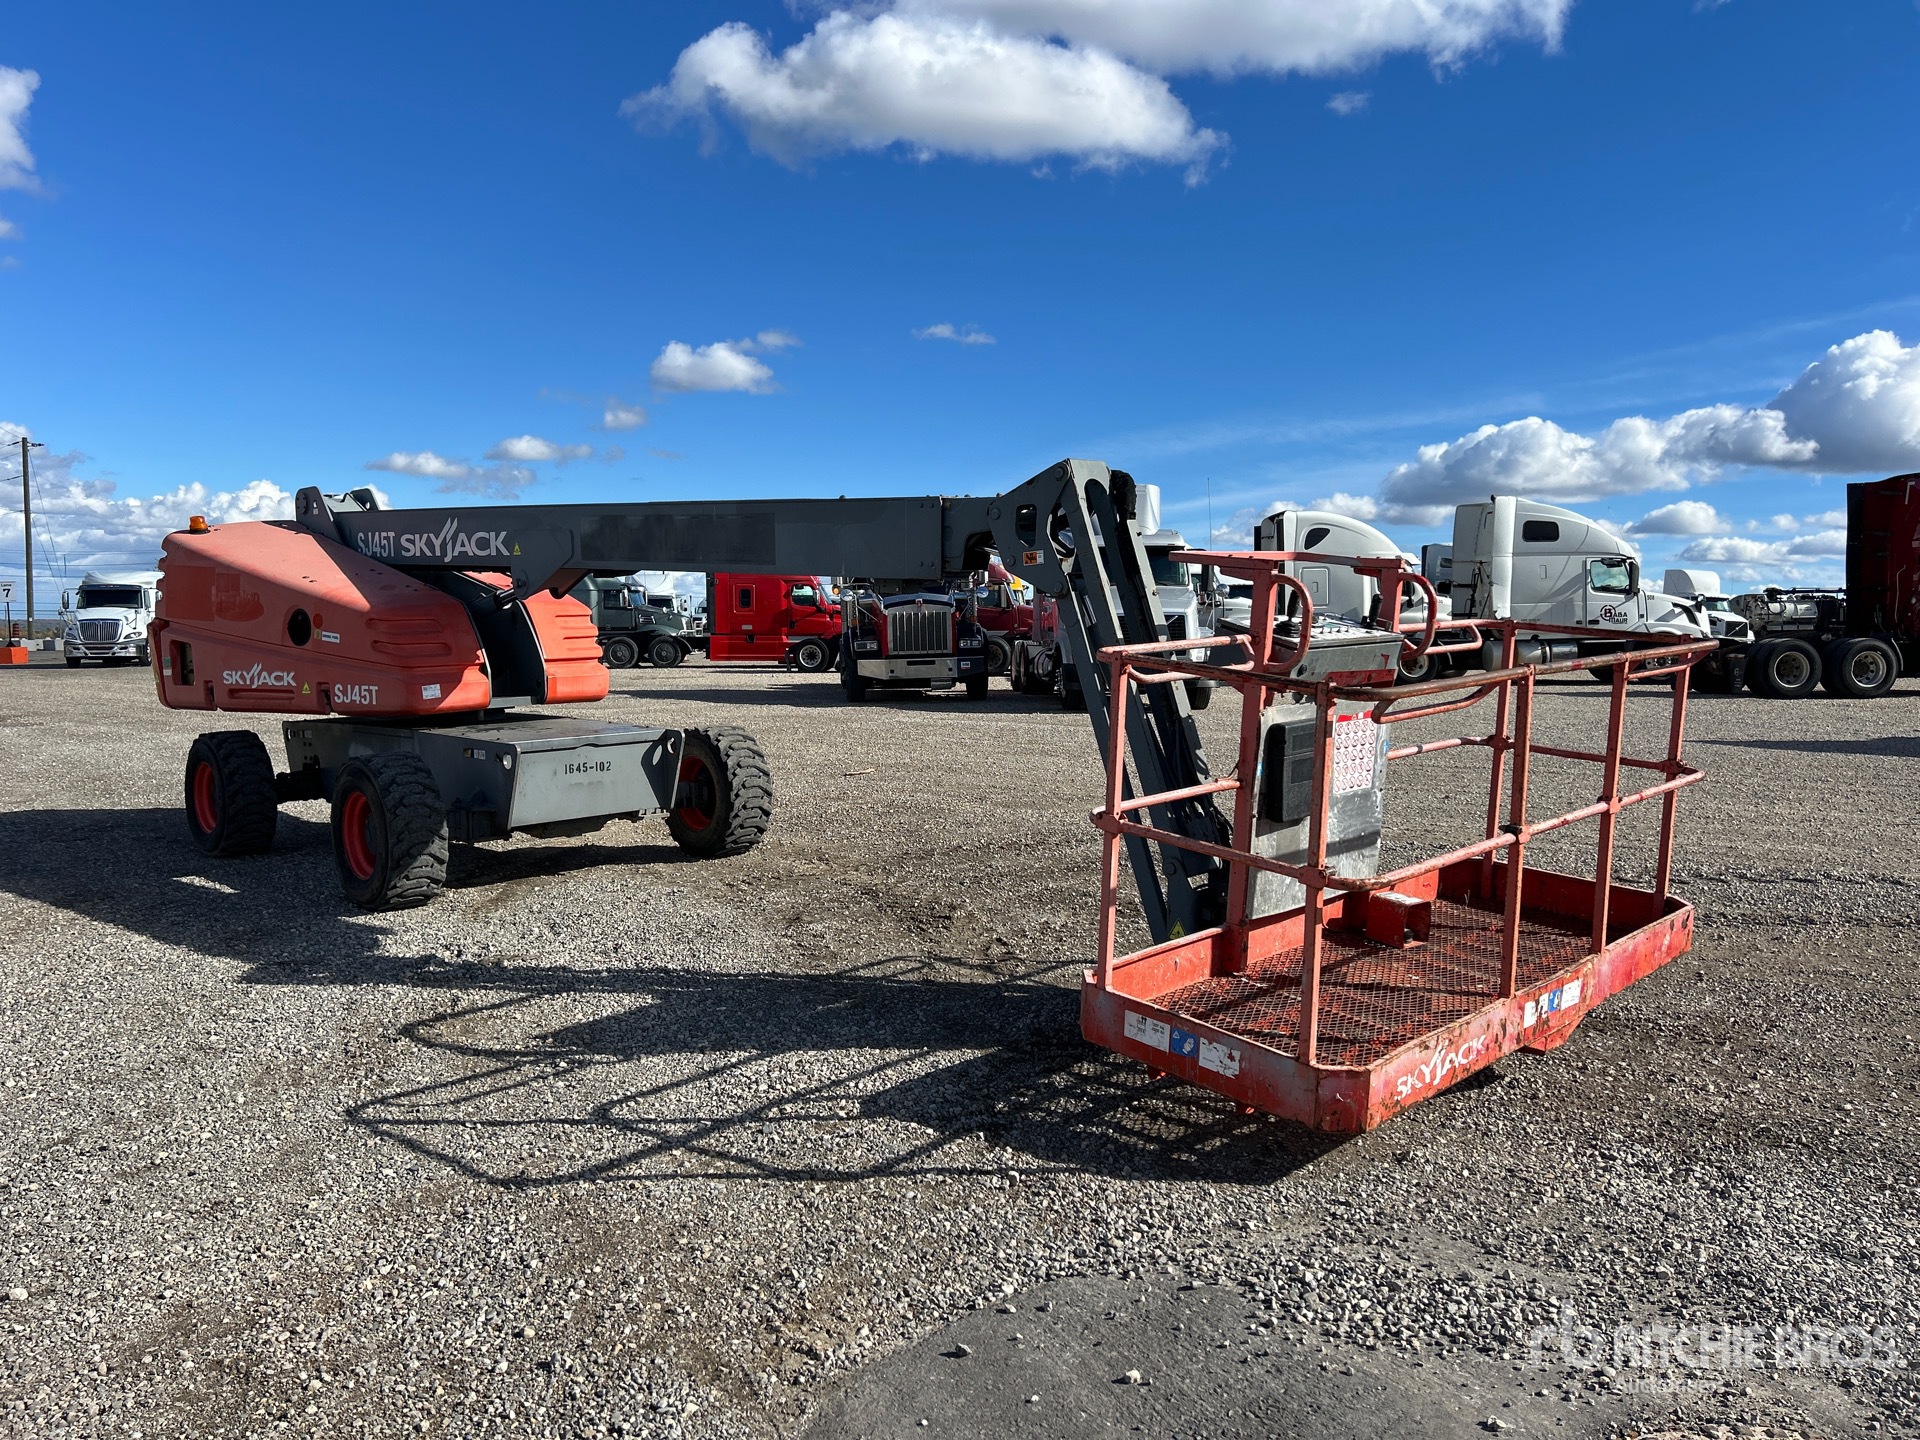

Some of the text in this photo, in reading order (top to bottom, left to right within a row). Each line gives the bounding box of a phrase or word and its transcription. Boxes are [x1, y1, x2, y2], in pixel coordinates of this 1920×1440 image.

[358, 517, 510, 562] SJ45T SKYJACK
[3, 588, 11, 598] 7
[222, 662, 297, 688] SKYJACK
[334, 683, 379, 705] SJ45T
[564, 760, 612, 775] 1645-102
[1394, 1035, 1487, 1101] SKYJACK
